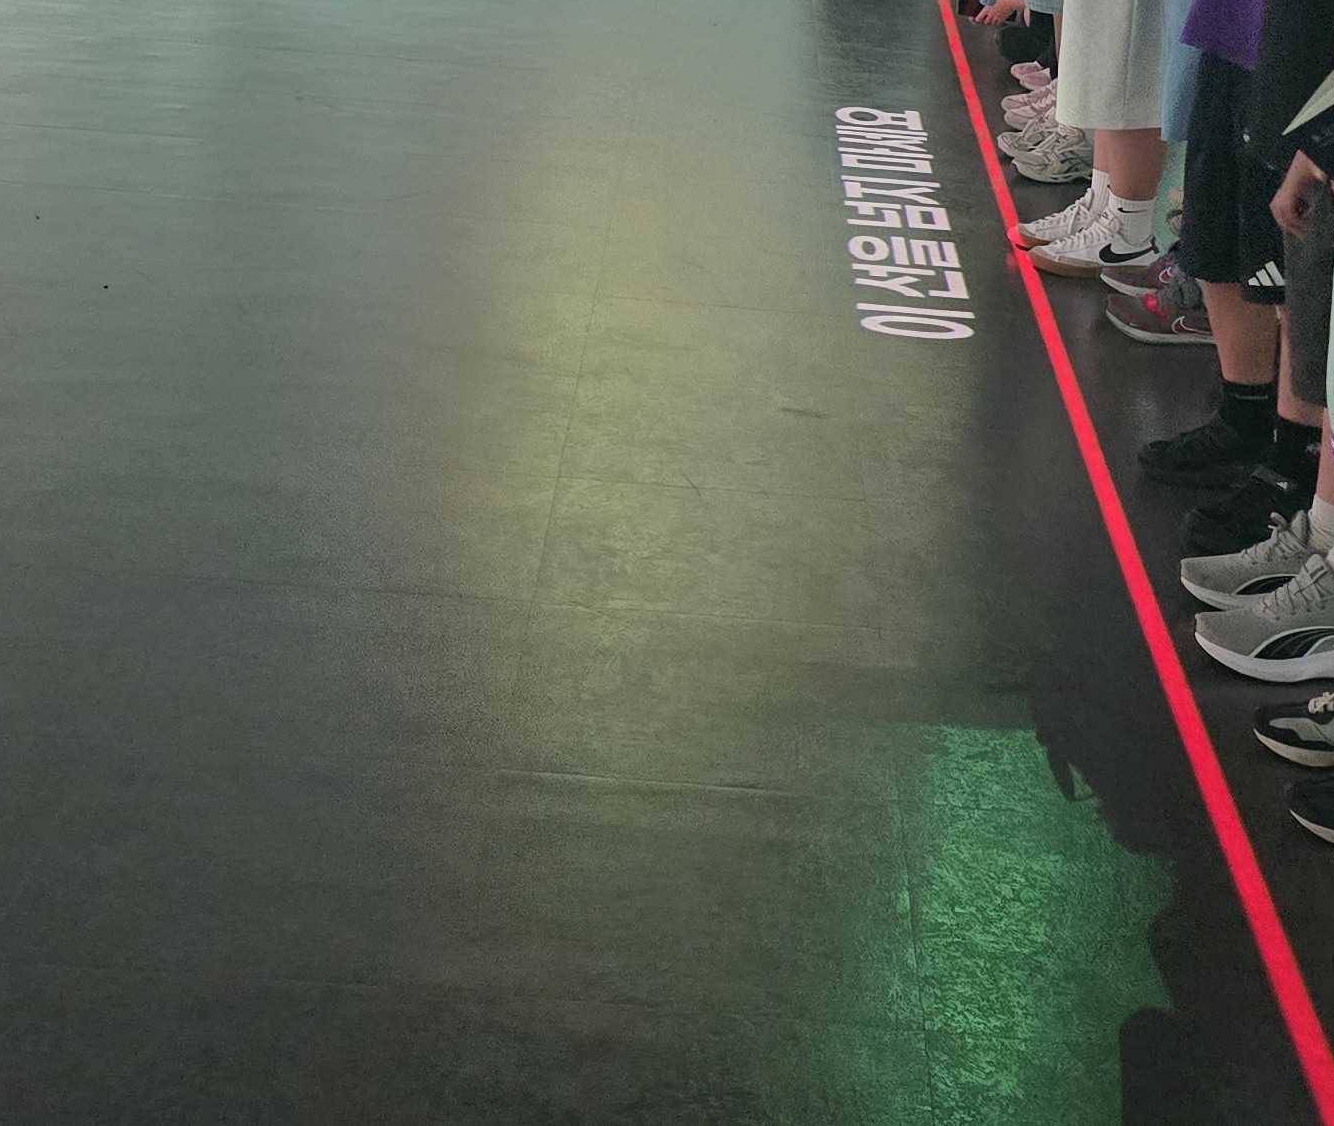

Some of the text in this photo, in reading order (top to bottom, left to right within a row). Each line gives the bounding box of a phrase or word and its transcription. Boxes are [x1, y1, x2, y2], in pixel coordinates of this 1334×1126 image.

[835, 106, 975, 339] 이 선을 넘지 마세요
